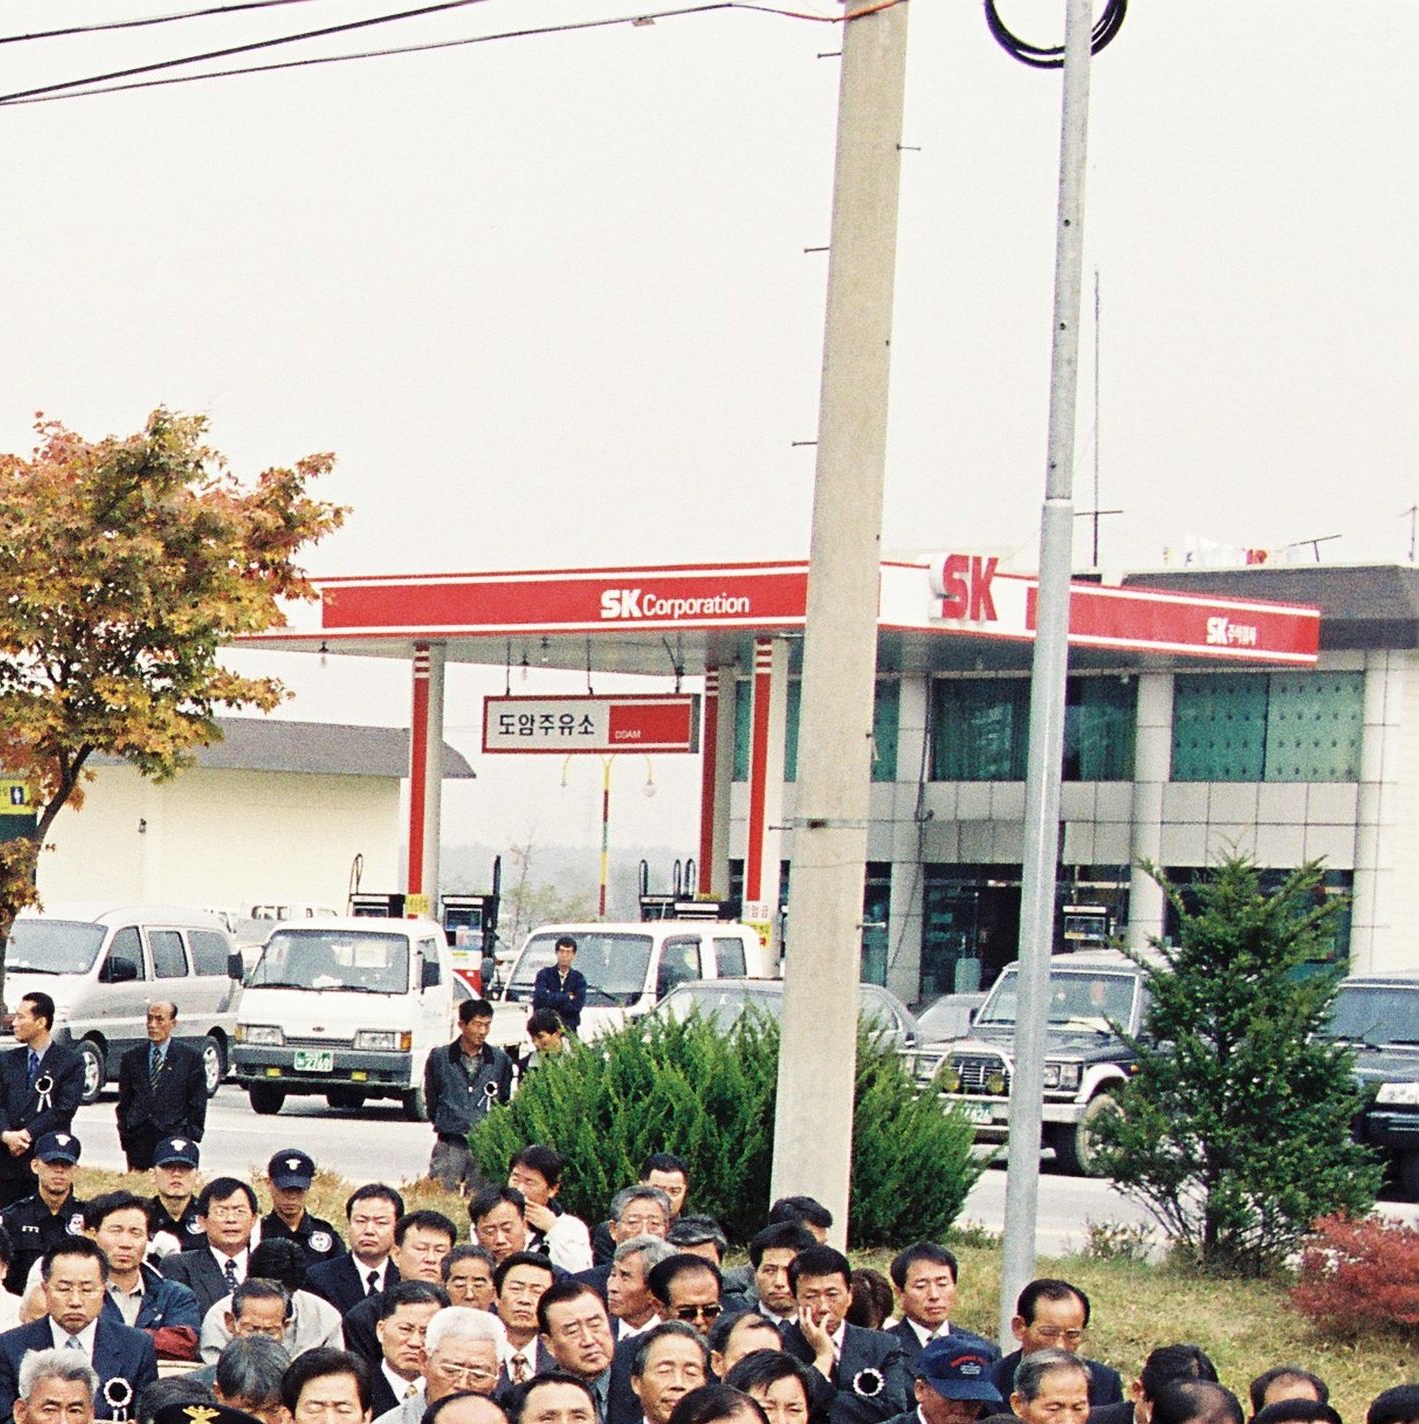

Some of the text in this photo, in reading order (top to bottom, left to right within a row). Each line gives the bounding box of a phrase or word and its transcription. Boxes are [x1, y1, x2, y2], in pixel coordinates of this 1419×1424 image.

[941, 553, 999, 621] SK
[600, 588, 750, 619] SK Corporation
[1206, 616, 1229, 645] SK
[498, 713, 595, 736] 도암주유소
